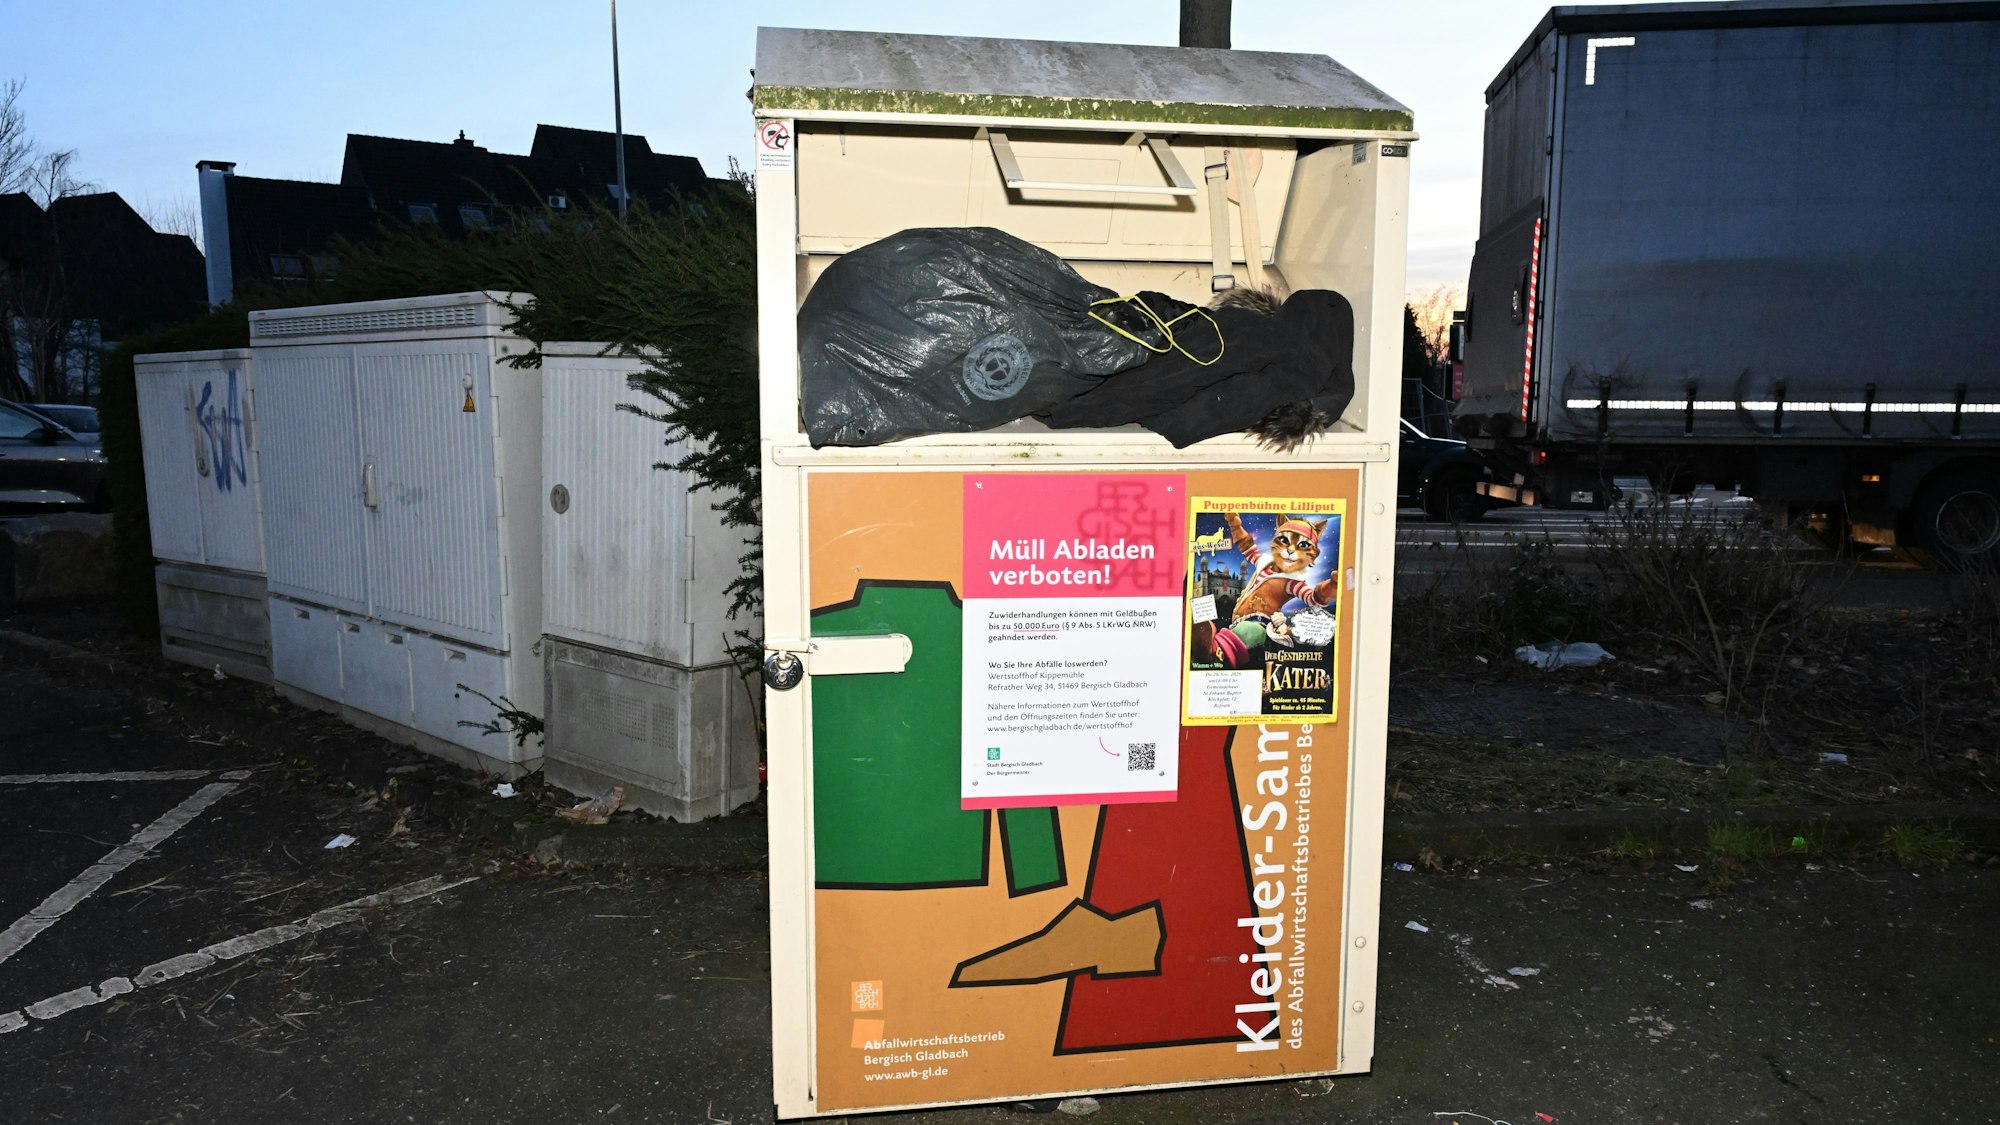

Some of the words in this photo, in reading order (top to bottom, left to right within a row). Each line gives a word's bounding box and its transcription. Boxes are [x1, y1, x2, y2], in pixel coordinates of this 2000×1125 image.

[1203, 500, 1287, 512] Puppenbühne
[1290, 501, 1335, 512] Lilliput
[990, 538, 1044, 560] Müll
[1053, 538, 1155, 560] Abladen
[989, 564, 1111, 586] verboten!
[989, 611, 1067, 620] Zuwiderhandlungen
[1116, 610, 1157, 618] Geldbußen
[1013, 622, 1040, 630] 50.000
[1078, 621, 1095, 629] Abs.
[1132, 620, 1156, 629] NRW)
[988, 634, 1025, 643] geahndet
[1035, 660, 1062, 668] Abfälle
[988, 672, 1038, 680] Wertstoffhof
[1040, 671, 1084, 680] Kippemühle
[1265, 661, 1327, 692] KATER
[1026, 683, 1042, 692] Weg
[1081, 681, 1111, 691] Bergisch
[1091, 700, 1140, 708] Wertstoffhof
[1020, 712, 1078, 722] Öffnungszeiten
[987, 721, 1133, 733] www.bergischgladbach.de/wertstoffhof
[1287, 753, 1312, 1012] Abfallwirtschaftsbetriebes
[864, 1030, 1005, 1050] Abfallwirtschaftsbetrieb
[1286, 1018, 1303, 1050] des
[864, 1052, 912, 1066] Bergisch
[915, 1048, 968, 1062] Gladbach
[864, 1066, 948, 1081] www.awb-gl.de
